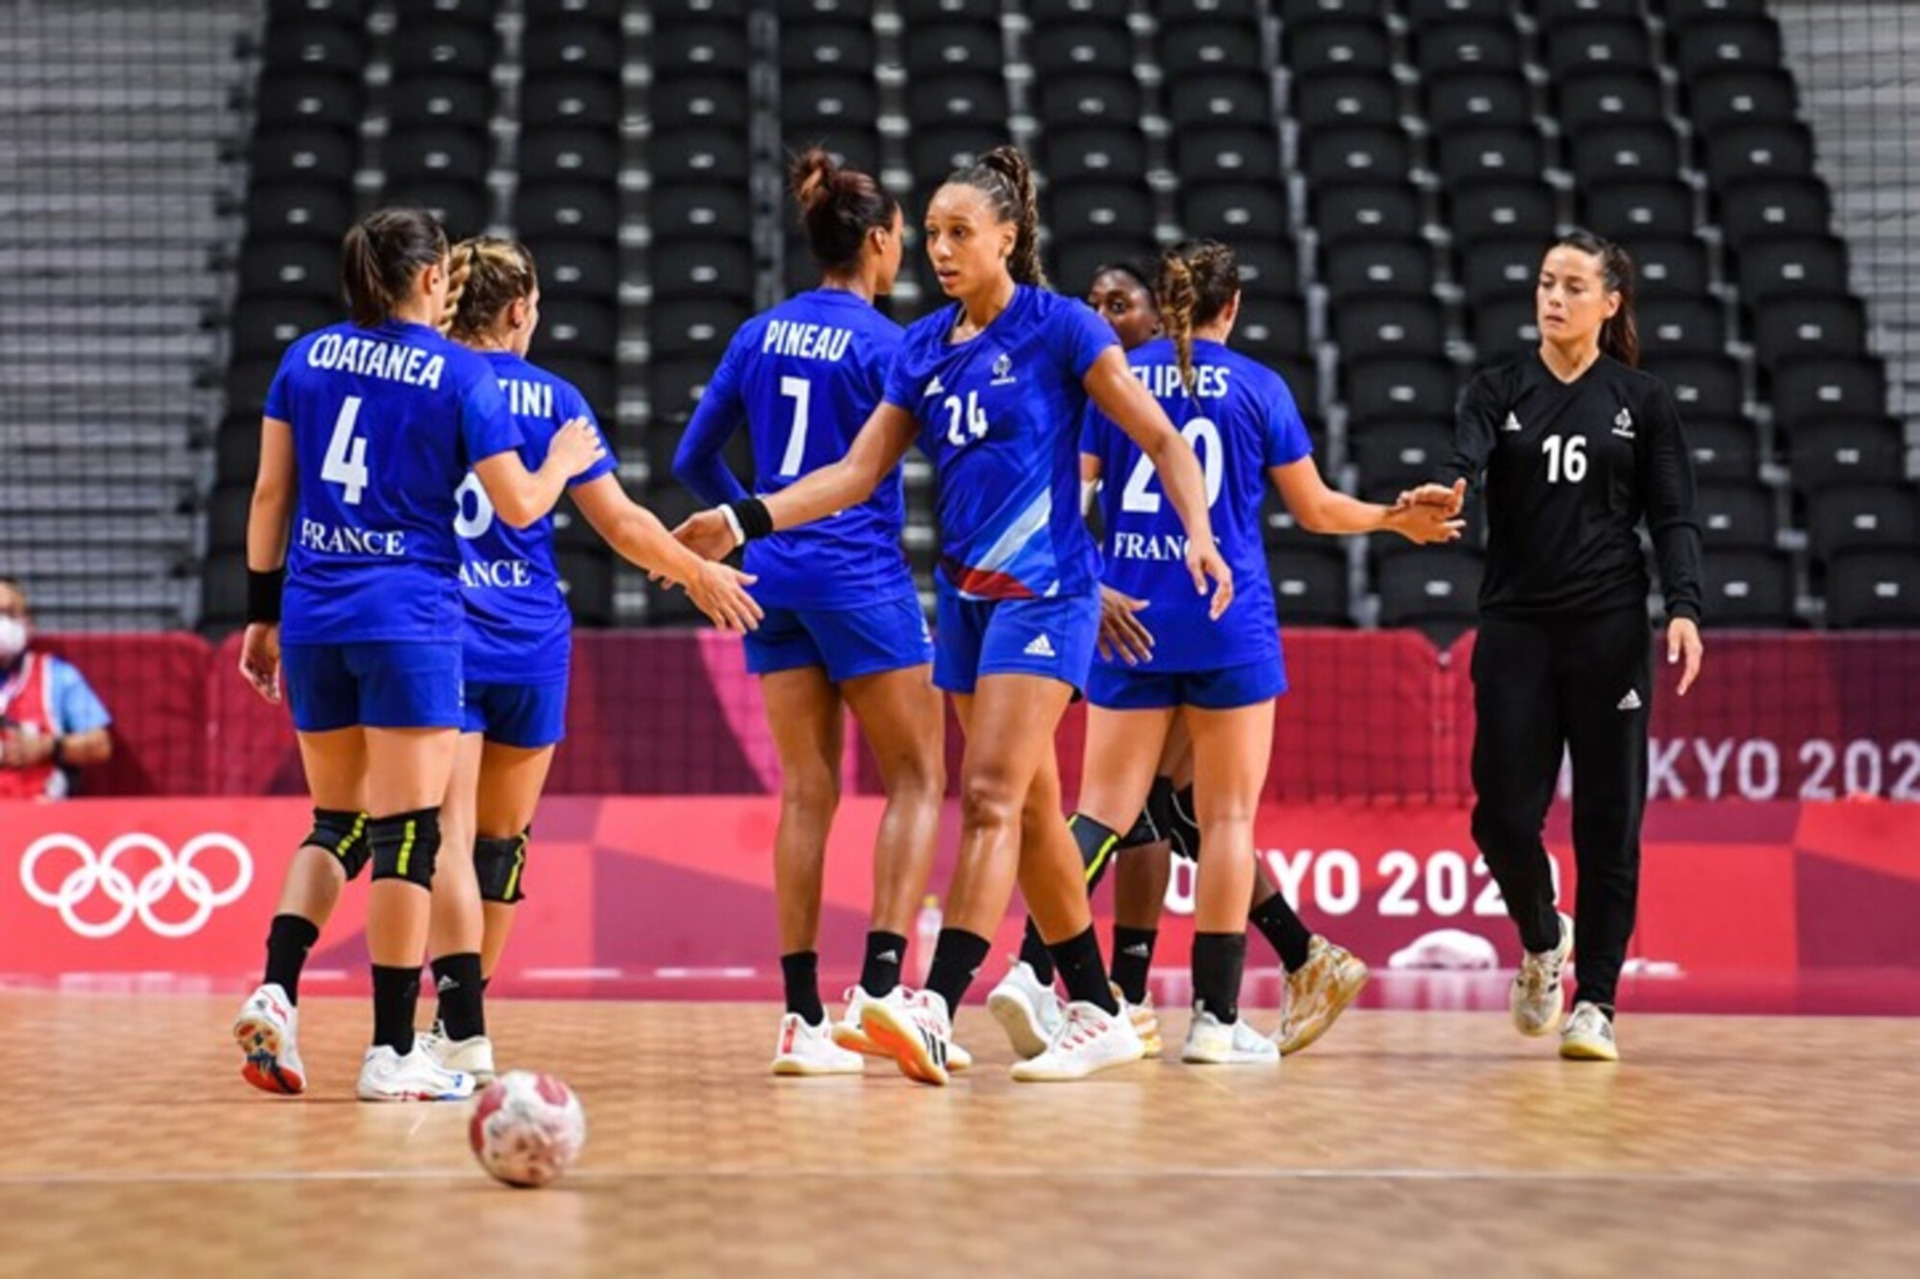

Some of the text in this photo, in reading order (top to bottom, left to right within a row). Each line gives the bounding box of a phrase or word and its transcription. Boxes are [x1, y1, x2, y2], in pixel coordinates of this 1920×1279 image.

[307, 333, 445, 390] COATANEA
[763, 320, 851, 362] PINEAU
[781, 375, 811, 477] 7
[945, 391, 988, 446] 24
[320, 396, 368, 505] 4
[1542, 434, 1588, 483] 16
[300, 519, 405, 555] FRANCE
[1113, 532, 1221, 561] FRAN
[1377, 849, 1560, 917] 202
